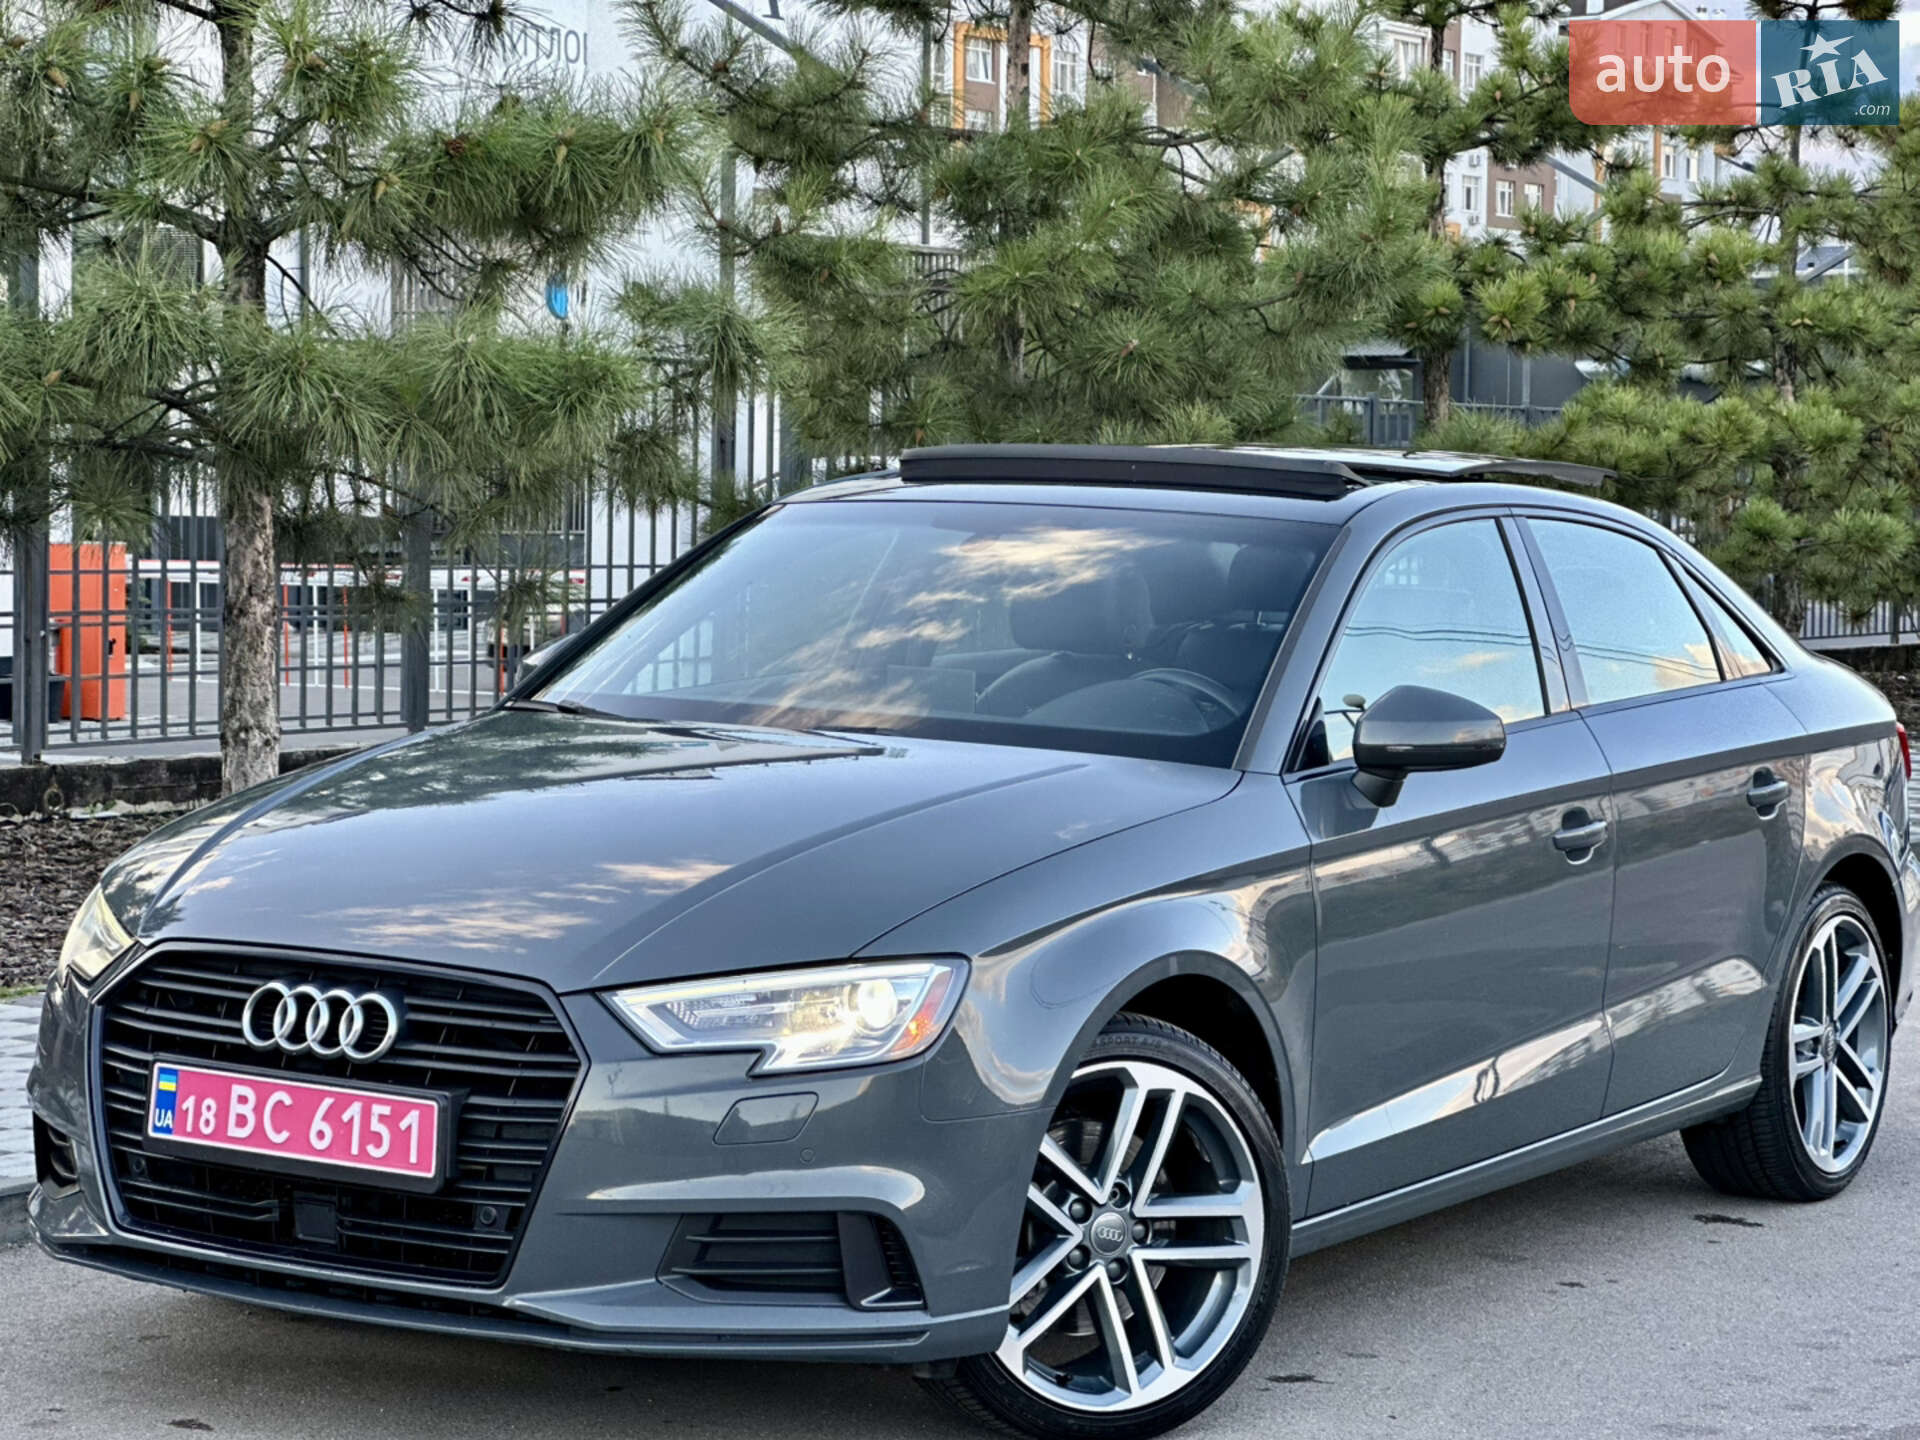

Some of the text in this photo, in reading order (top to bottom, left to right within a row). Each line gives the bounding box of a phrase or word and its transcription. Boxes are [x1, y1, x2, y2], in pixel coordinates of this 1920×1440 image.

[154, 1108, 173, 1129] UA
[181, 1084, 421, 1164] 18 BC 6151
